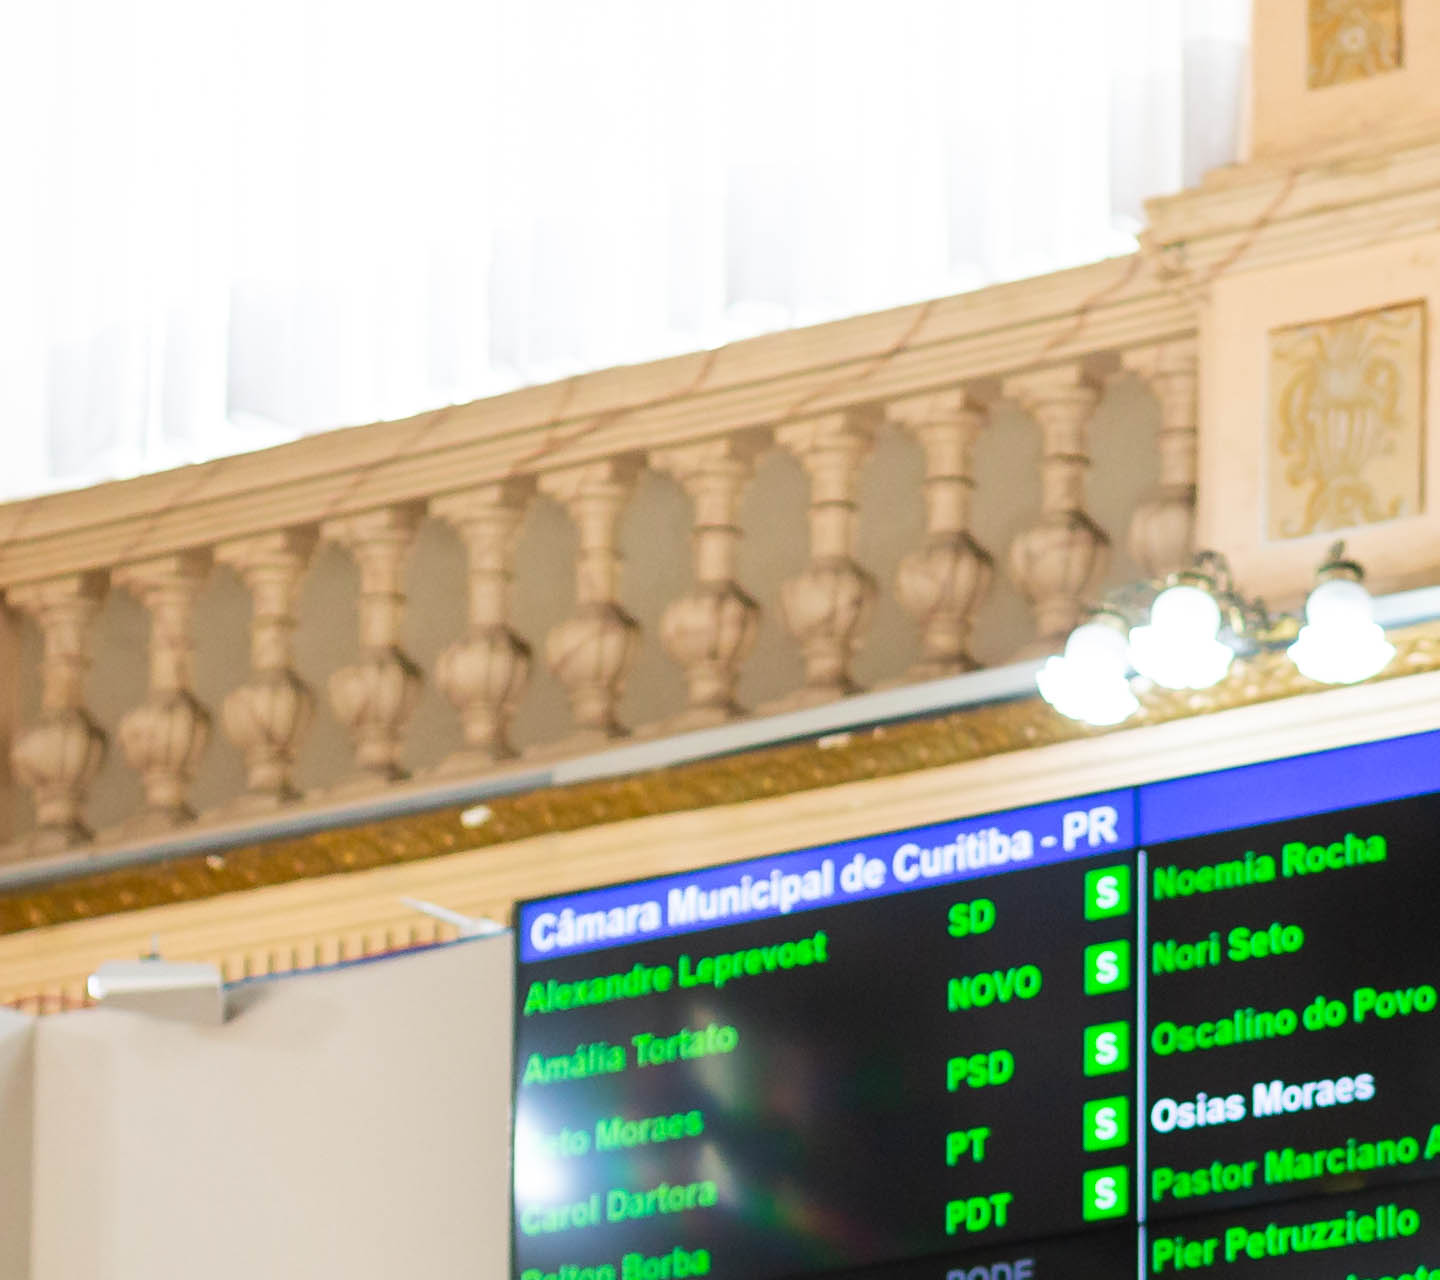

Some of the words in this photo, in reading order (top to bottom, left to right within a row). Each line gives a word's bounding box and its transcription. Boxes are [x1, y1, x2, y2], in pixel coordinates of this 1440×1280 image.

[530, 907, 662, 953] Câmara
[668, 860, 835, 919] Municipal
[839, 853, 887, 888] de
[892, 827, 1034, 883] Curitiba
[1062, 805, 1118, 852] PR
[1153, 851, 1276, 900] Noemia
[1281, 833, 1387, 878] Rocha
[523, 963, 673, 1016] Alexandre
[678, 931, 827, 988] Leprevost
[1152, 931, 1221, 974] Nori
[1227, 922, 1304, 962] Seto
[947, 964, 1042, 1011] NOVO
[1151, 1007, 1298, 1056] Oscalino
[1302, 995, 1347, 1031] do
[1353, 985, 1437, 1023] Povo
[946, 1049, 1014, 1091] PSD
[1150, 1092, 1247, 1133] Osias
[1252, 1073, 1375, 1118] Moraes
[1152, 1237, 1219, 1273] Pier
[1225, 1204, 1420, 1262] Petruzziello
